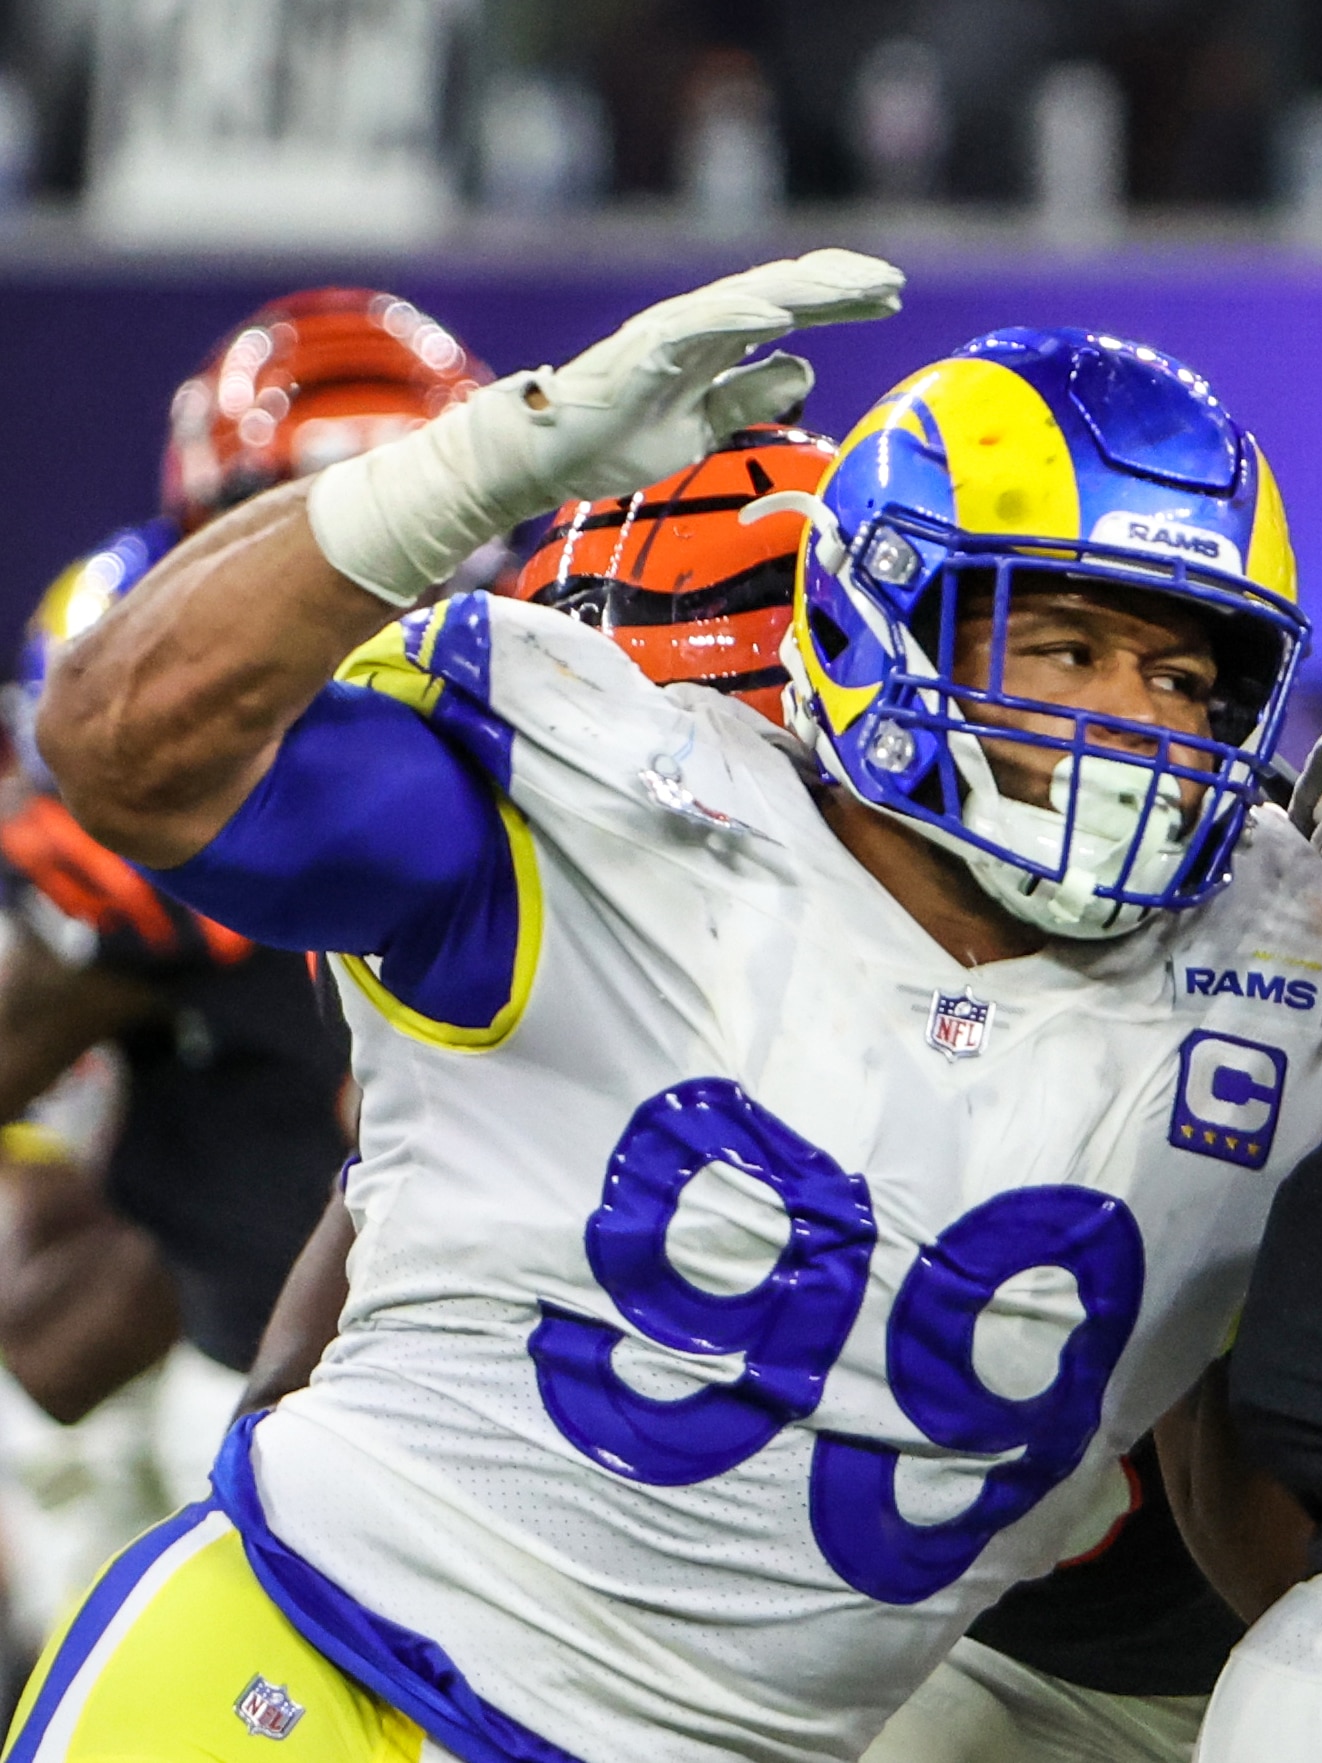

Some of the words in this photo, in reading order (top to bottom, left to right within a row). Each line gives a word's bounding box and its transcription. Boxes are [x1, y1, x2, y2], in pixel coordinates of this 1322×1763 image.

[1128, 522, 1220, 558] RAMS
[1185, 967, 1318, 1010] RAMS
[935, 1016, 977, 1048] NFL
[1185, 1038, 1277, 1133] C
[527, 1076, 1146, 1604] 99
[244, 1693, 284, 1731] NFL
